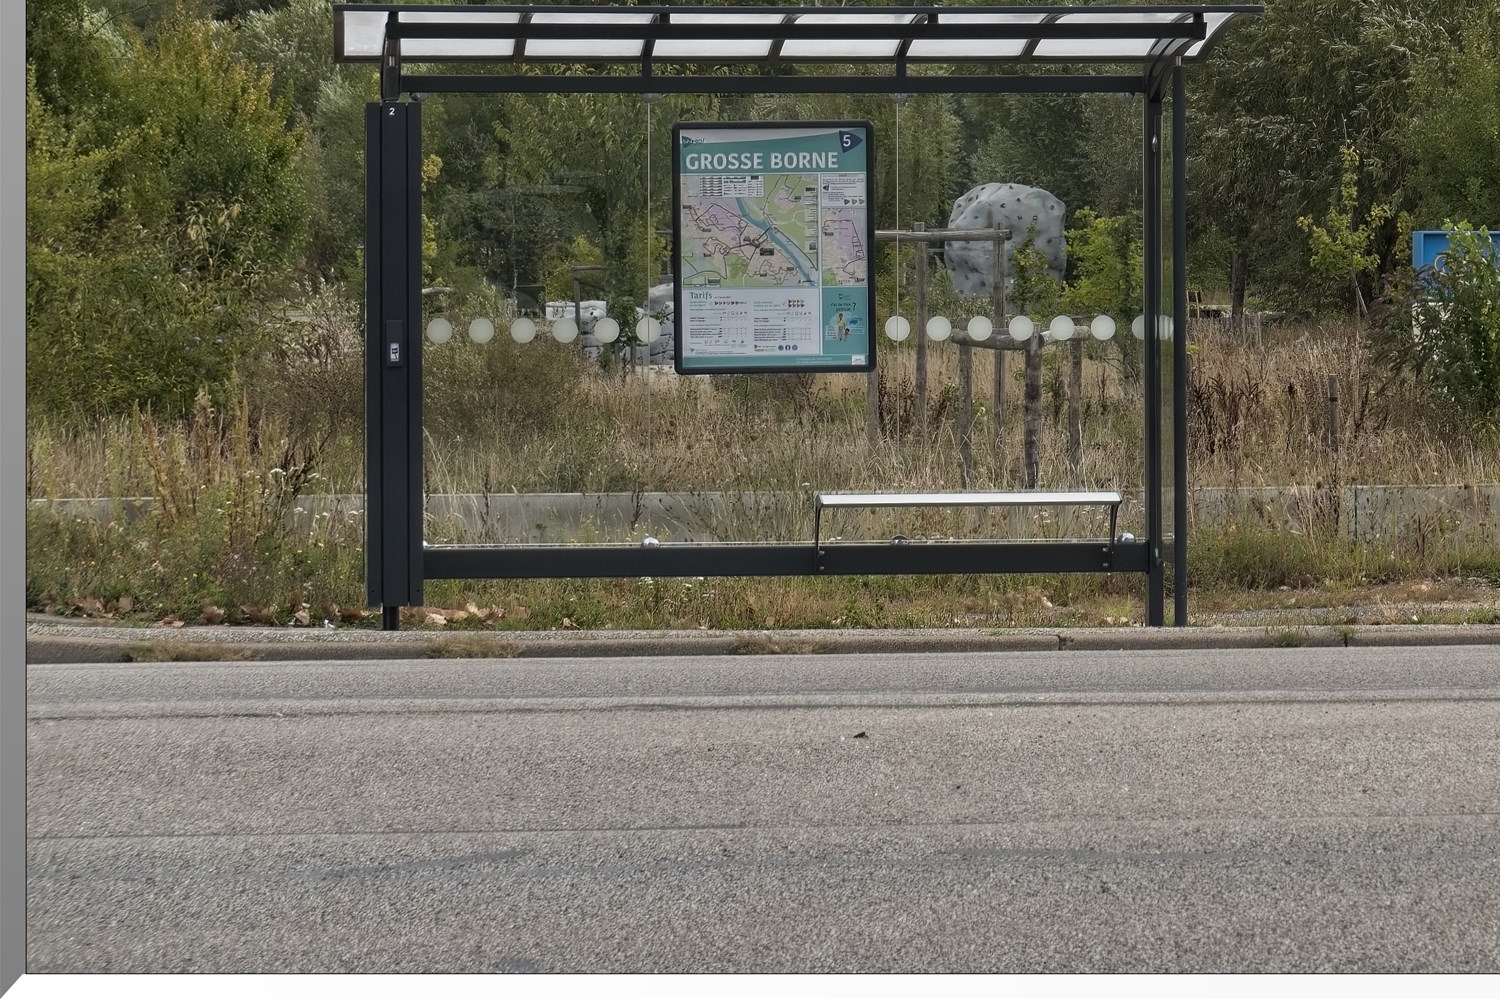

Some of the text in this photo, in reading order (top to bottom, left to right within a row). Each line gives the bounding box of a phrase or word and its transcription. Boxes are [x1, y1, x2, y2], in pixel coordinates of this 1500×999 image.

[389, 107, 395, 116] 2
[842, 134, 852, 147] 5
[685, 152, 839, 170] GROSSE BORNE
[689, 292, 713, 301] Tarifs
